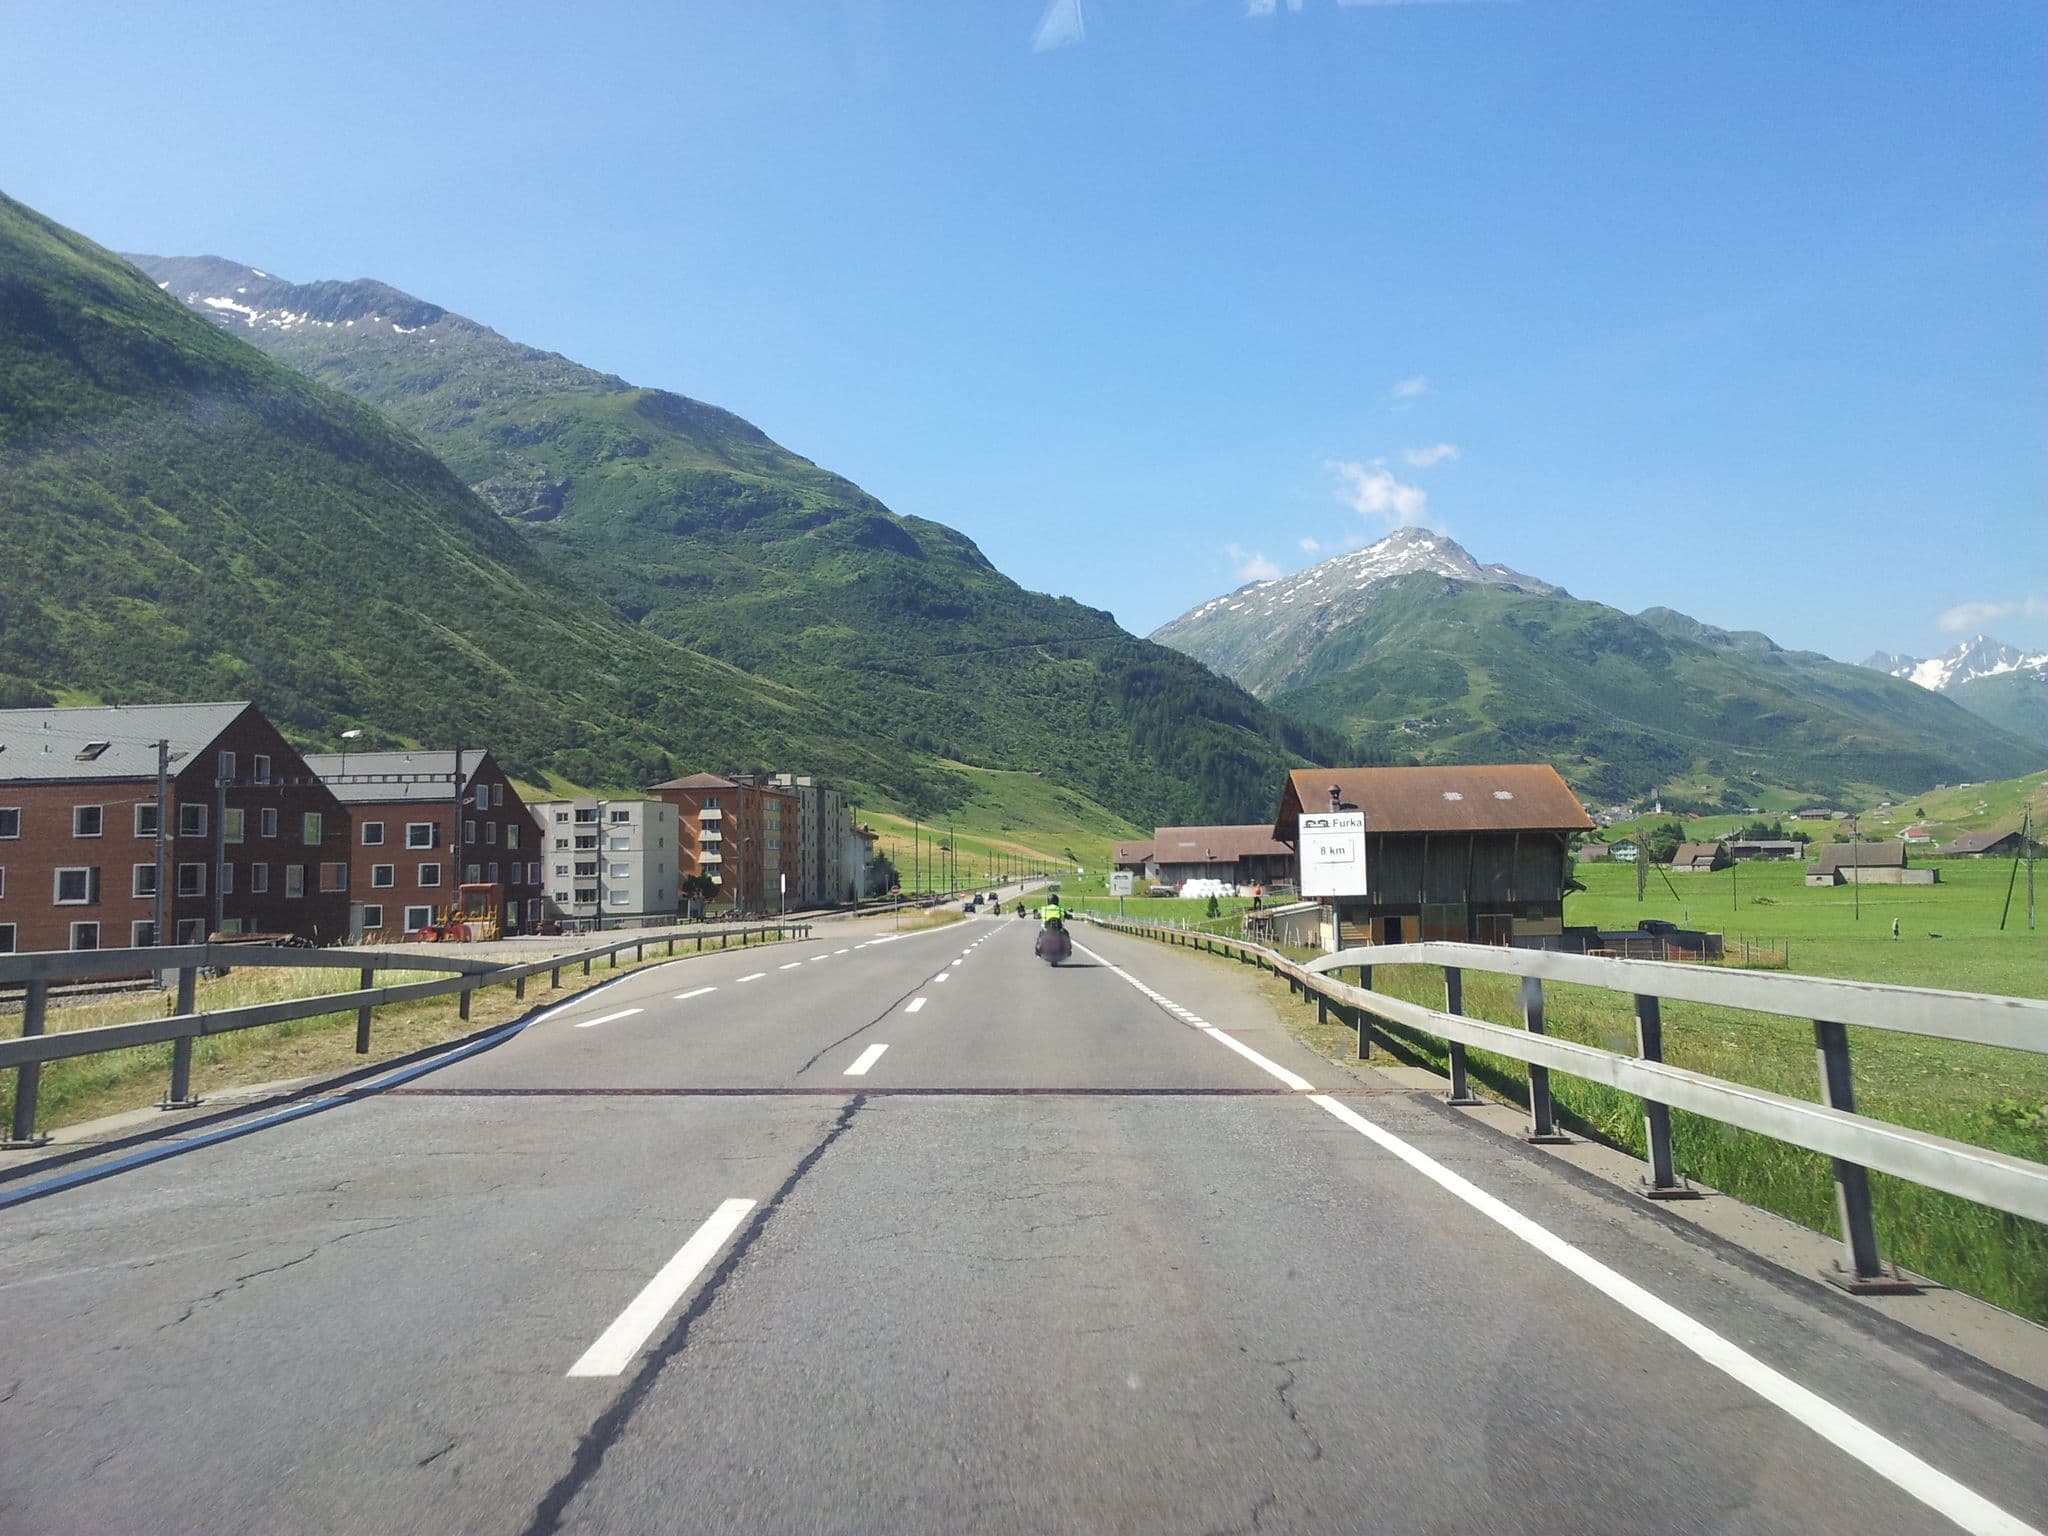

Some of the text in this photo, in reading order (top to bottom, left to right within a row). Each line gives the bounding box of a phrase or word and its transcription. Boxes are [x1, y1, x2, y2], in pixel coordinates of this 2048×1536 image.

[1332, 818, 1362, 828] Furka
[1320, 846, 1345, 855] 8 km
